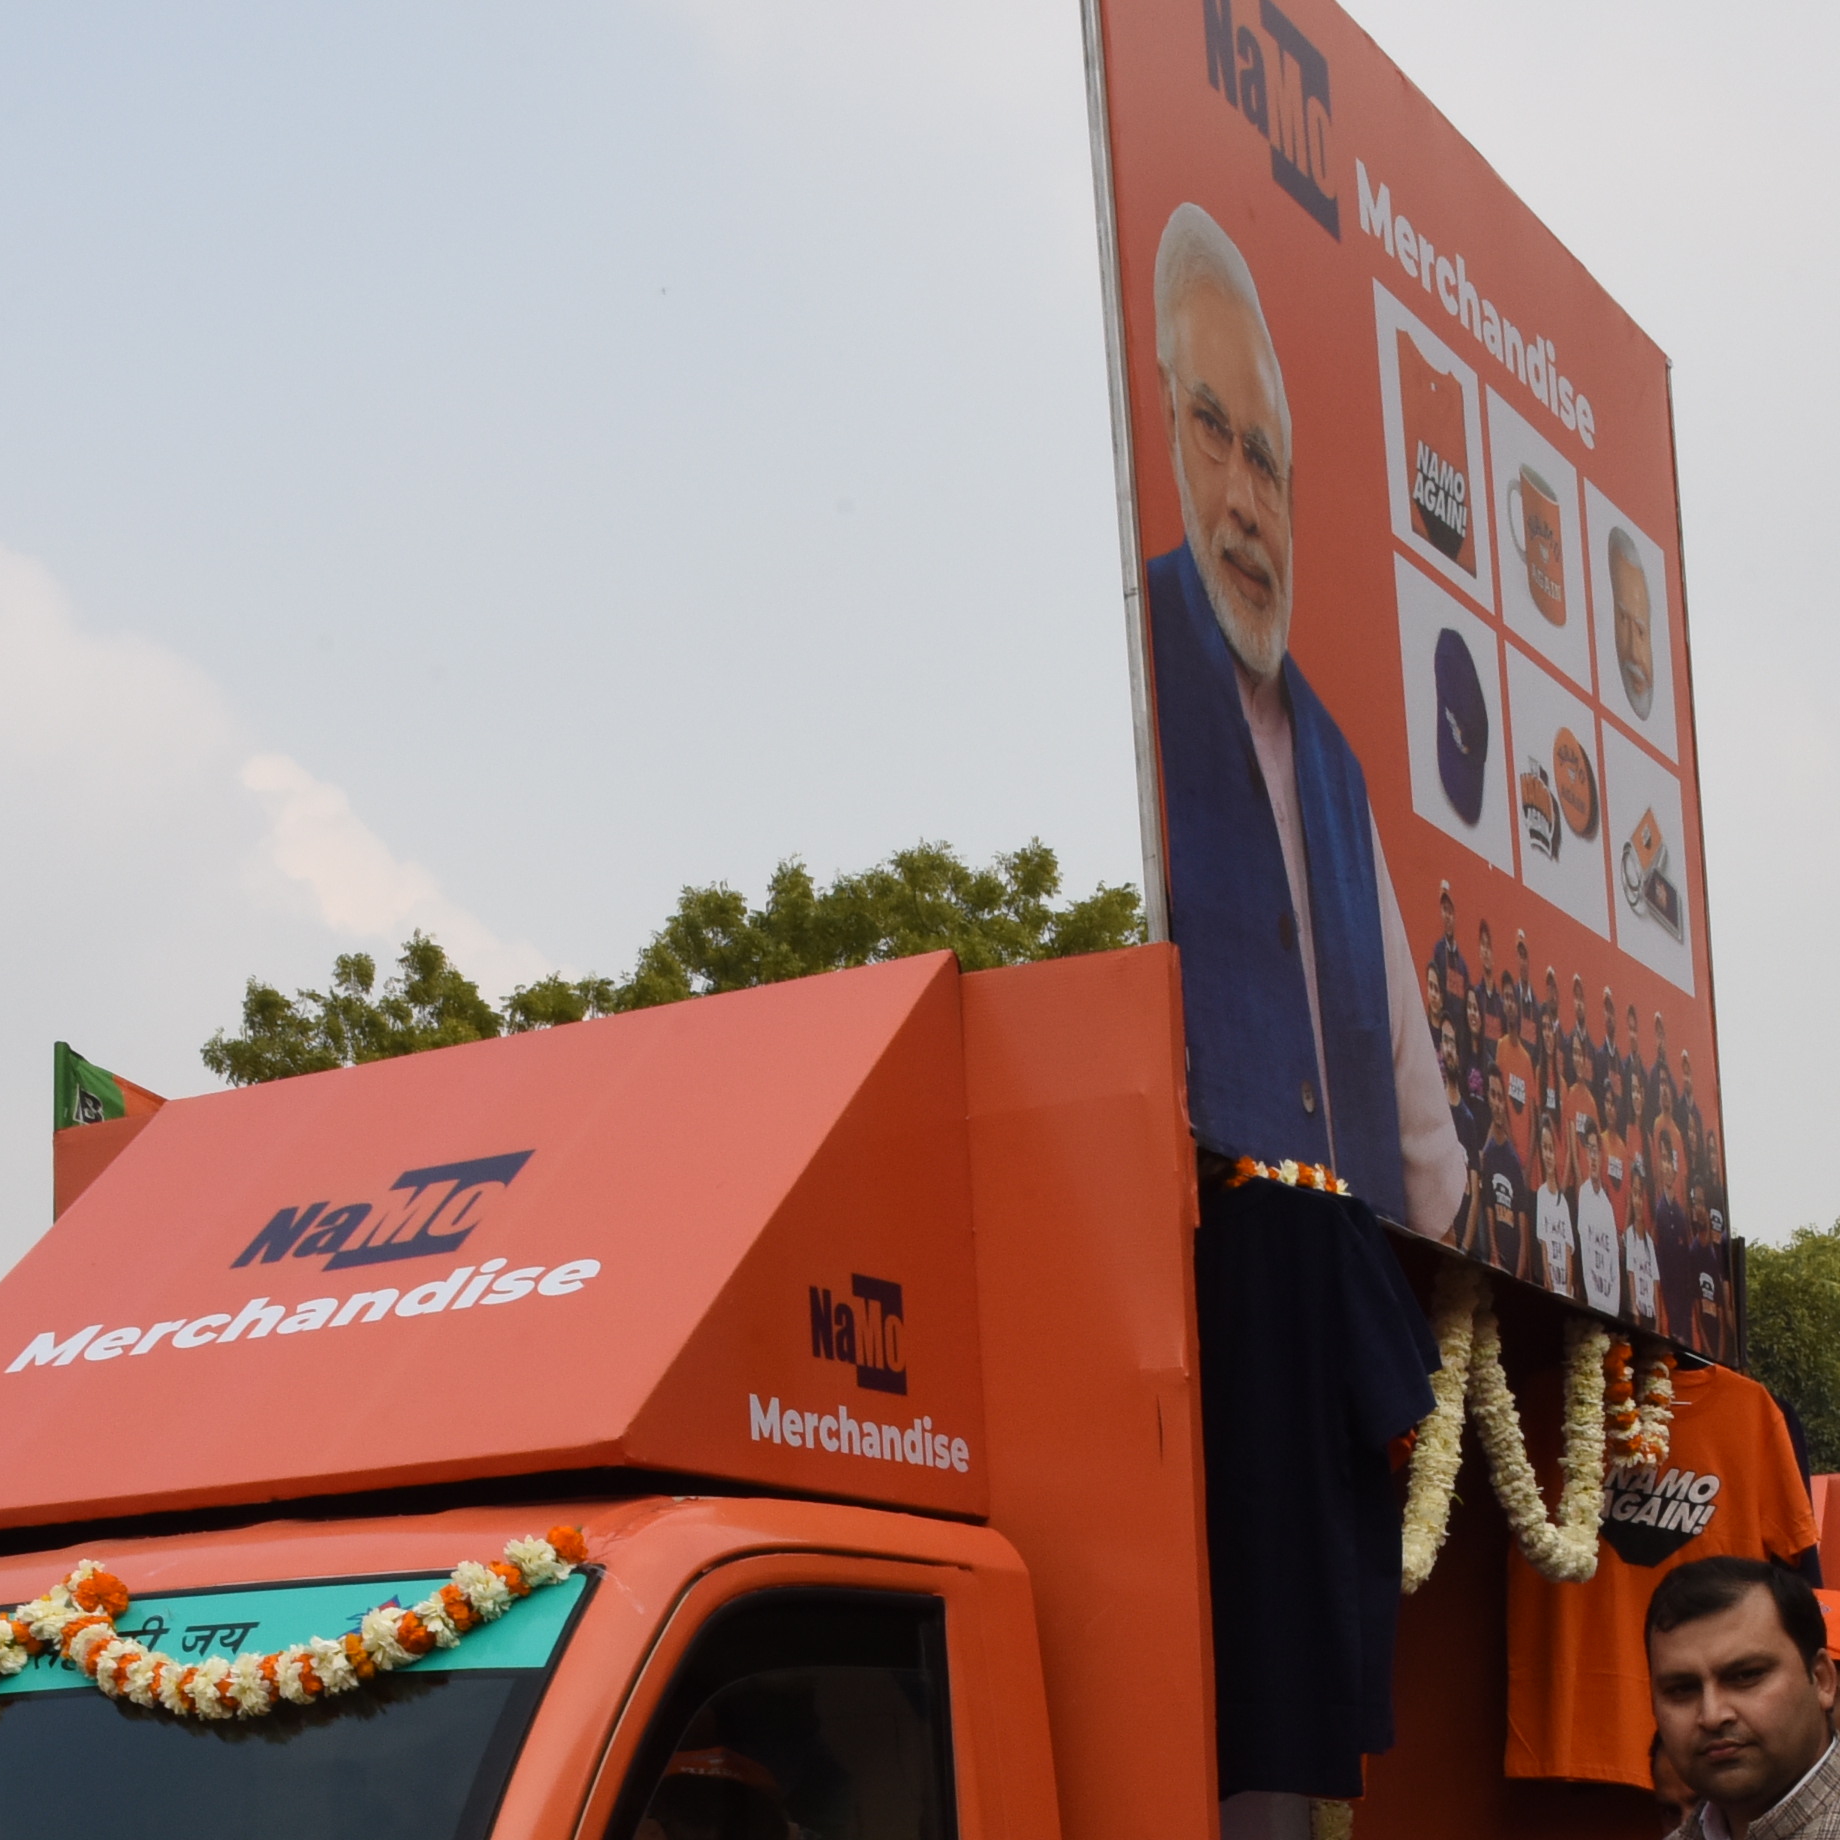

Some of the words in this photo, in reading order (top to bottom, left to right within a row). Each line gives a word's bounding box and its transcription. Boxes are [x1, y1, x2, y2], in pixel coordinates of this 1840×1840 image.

[1356, 157, 1595, 449] Merchandise
[1413, 471, 1468, 538] AGAIN!
[1417, 439, 1466, 503] NAMO
[229, 1150, 535, 1271] NaMo
[5, 1258, 601, 1374] Merchandise
[809, 1273, 908, 1395] NaMo
[749, 1393, 970, 1473] Merchandise
[1604, 1466, 1720, 1504] NAMO
[182, 1621, 260, 1657] जय
